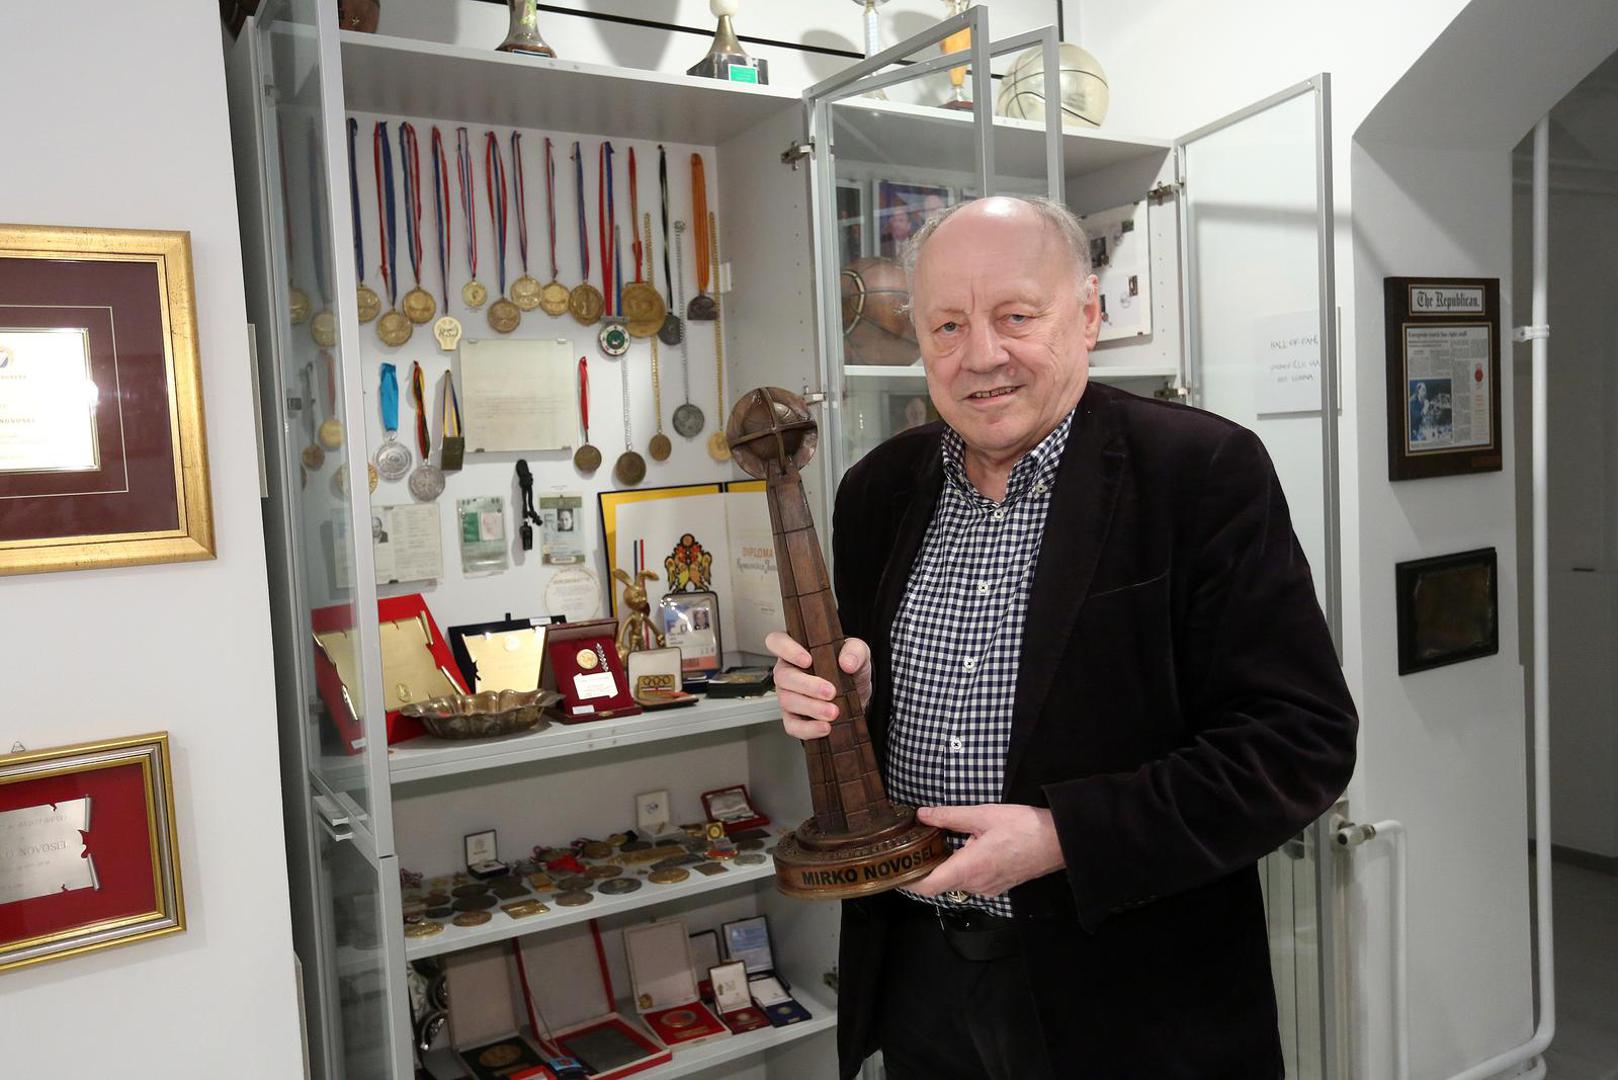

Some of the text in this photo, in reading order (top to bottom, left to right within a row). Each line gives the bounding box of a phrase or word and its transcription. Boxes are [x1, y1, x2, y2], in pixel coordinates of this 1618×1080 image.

[1416, 291, 1433, 309] The
[801, 868, 857, 886] MIRKO
[863, 846, 936, 880] NOVOSEL
